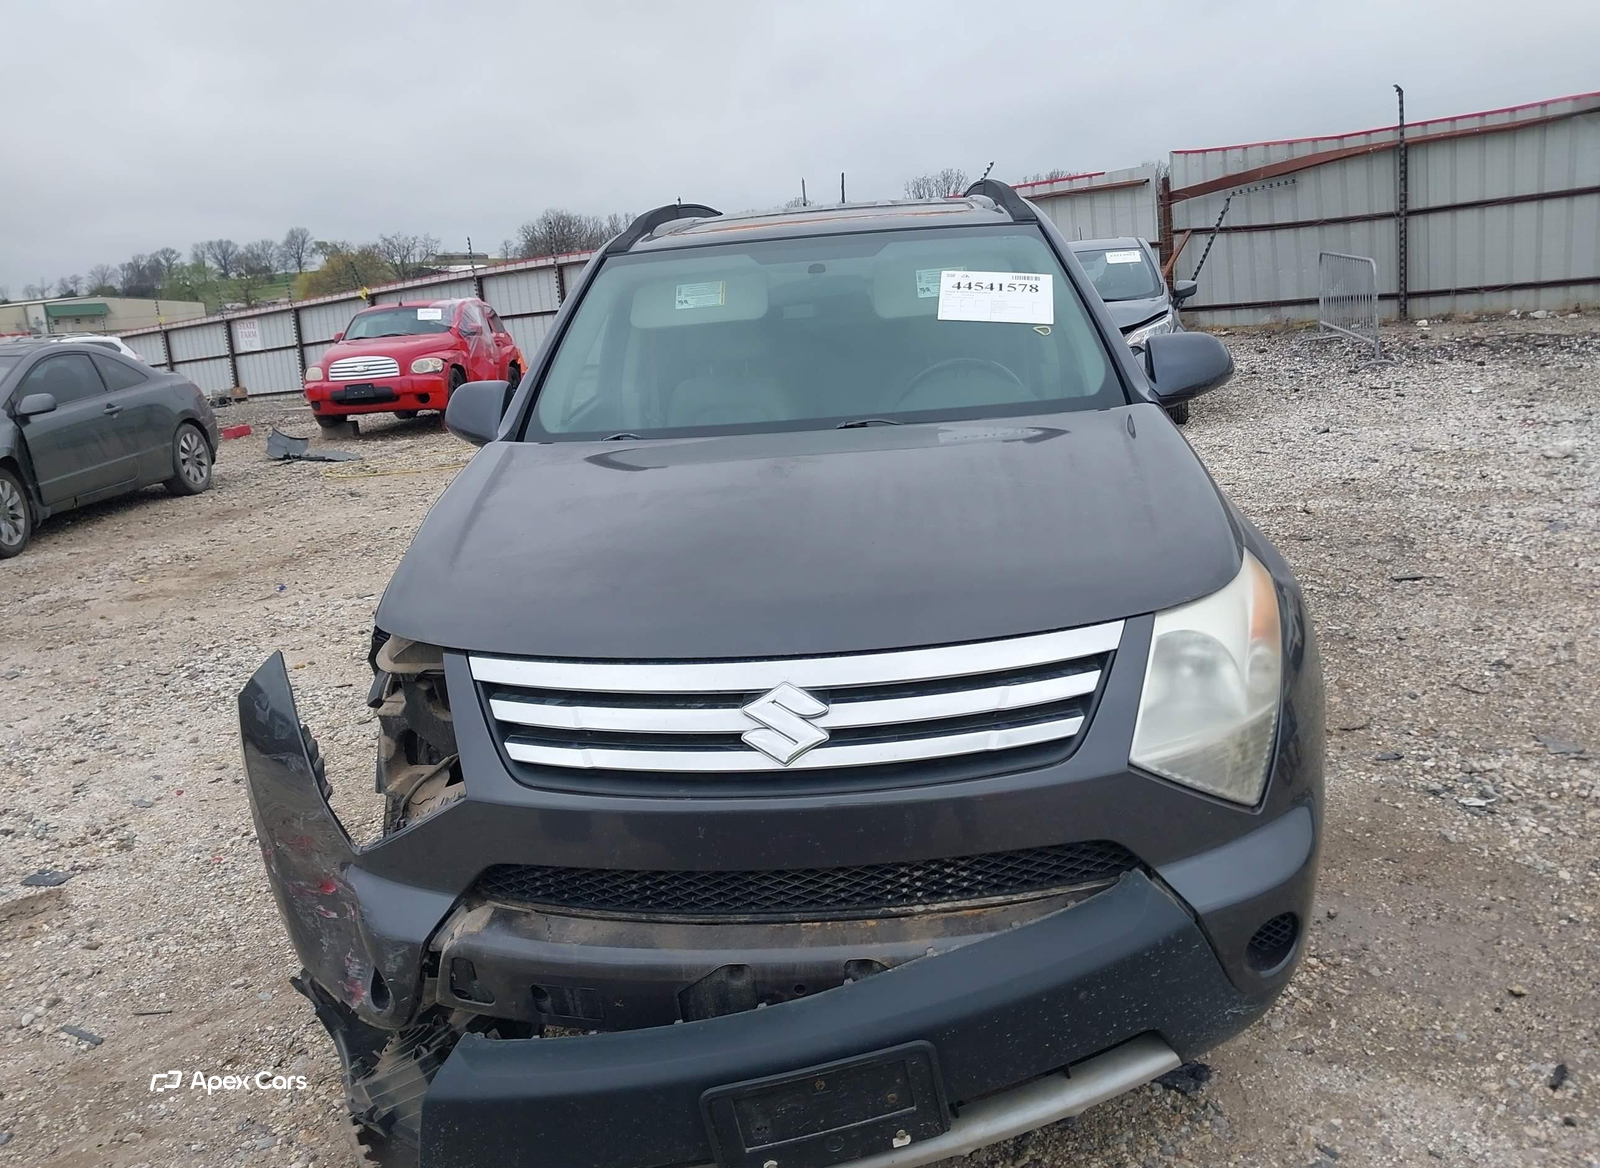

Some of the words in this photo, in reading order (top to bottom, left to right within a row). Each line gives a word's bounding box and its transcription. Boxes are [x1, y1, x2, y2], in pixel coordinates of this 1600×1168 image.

[951, 281, 1040, 294] 44541578
[239, 321, 257, 330] STATE
[240, 331, 258, 339] FARM
